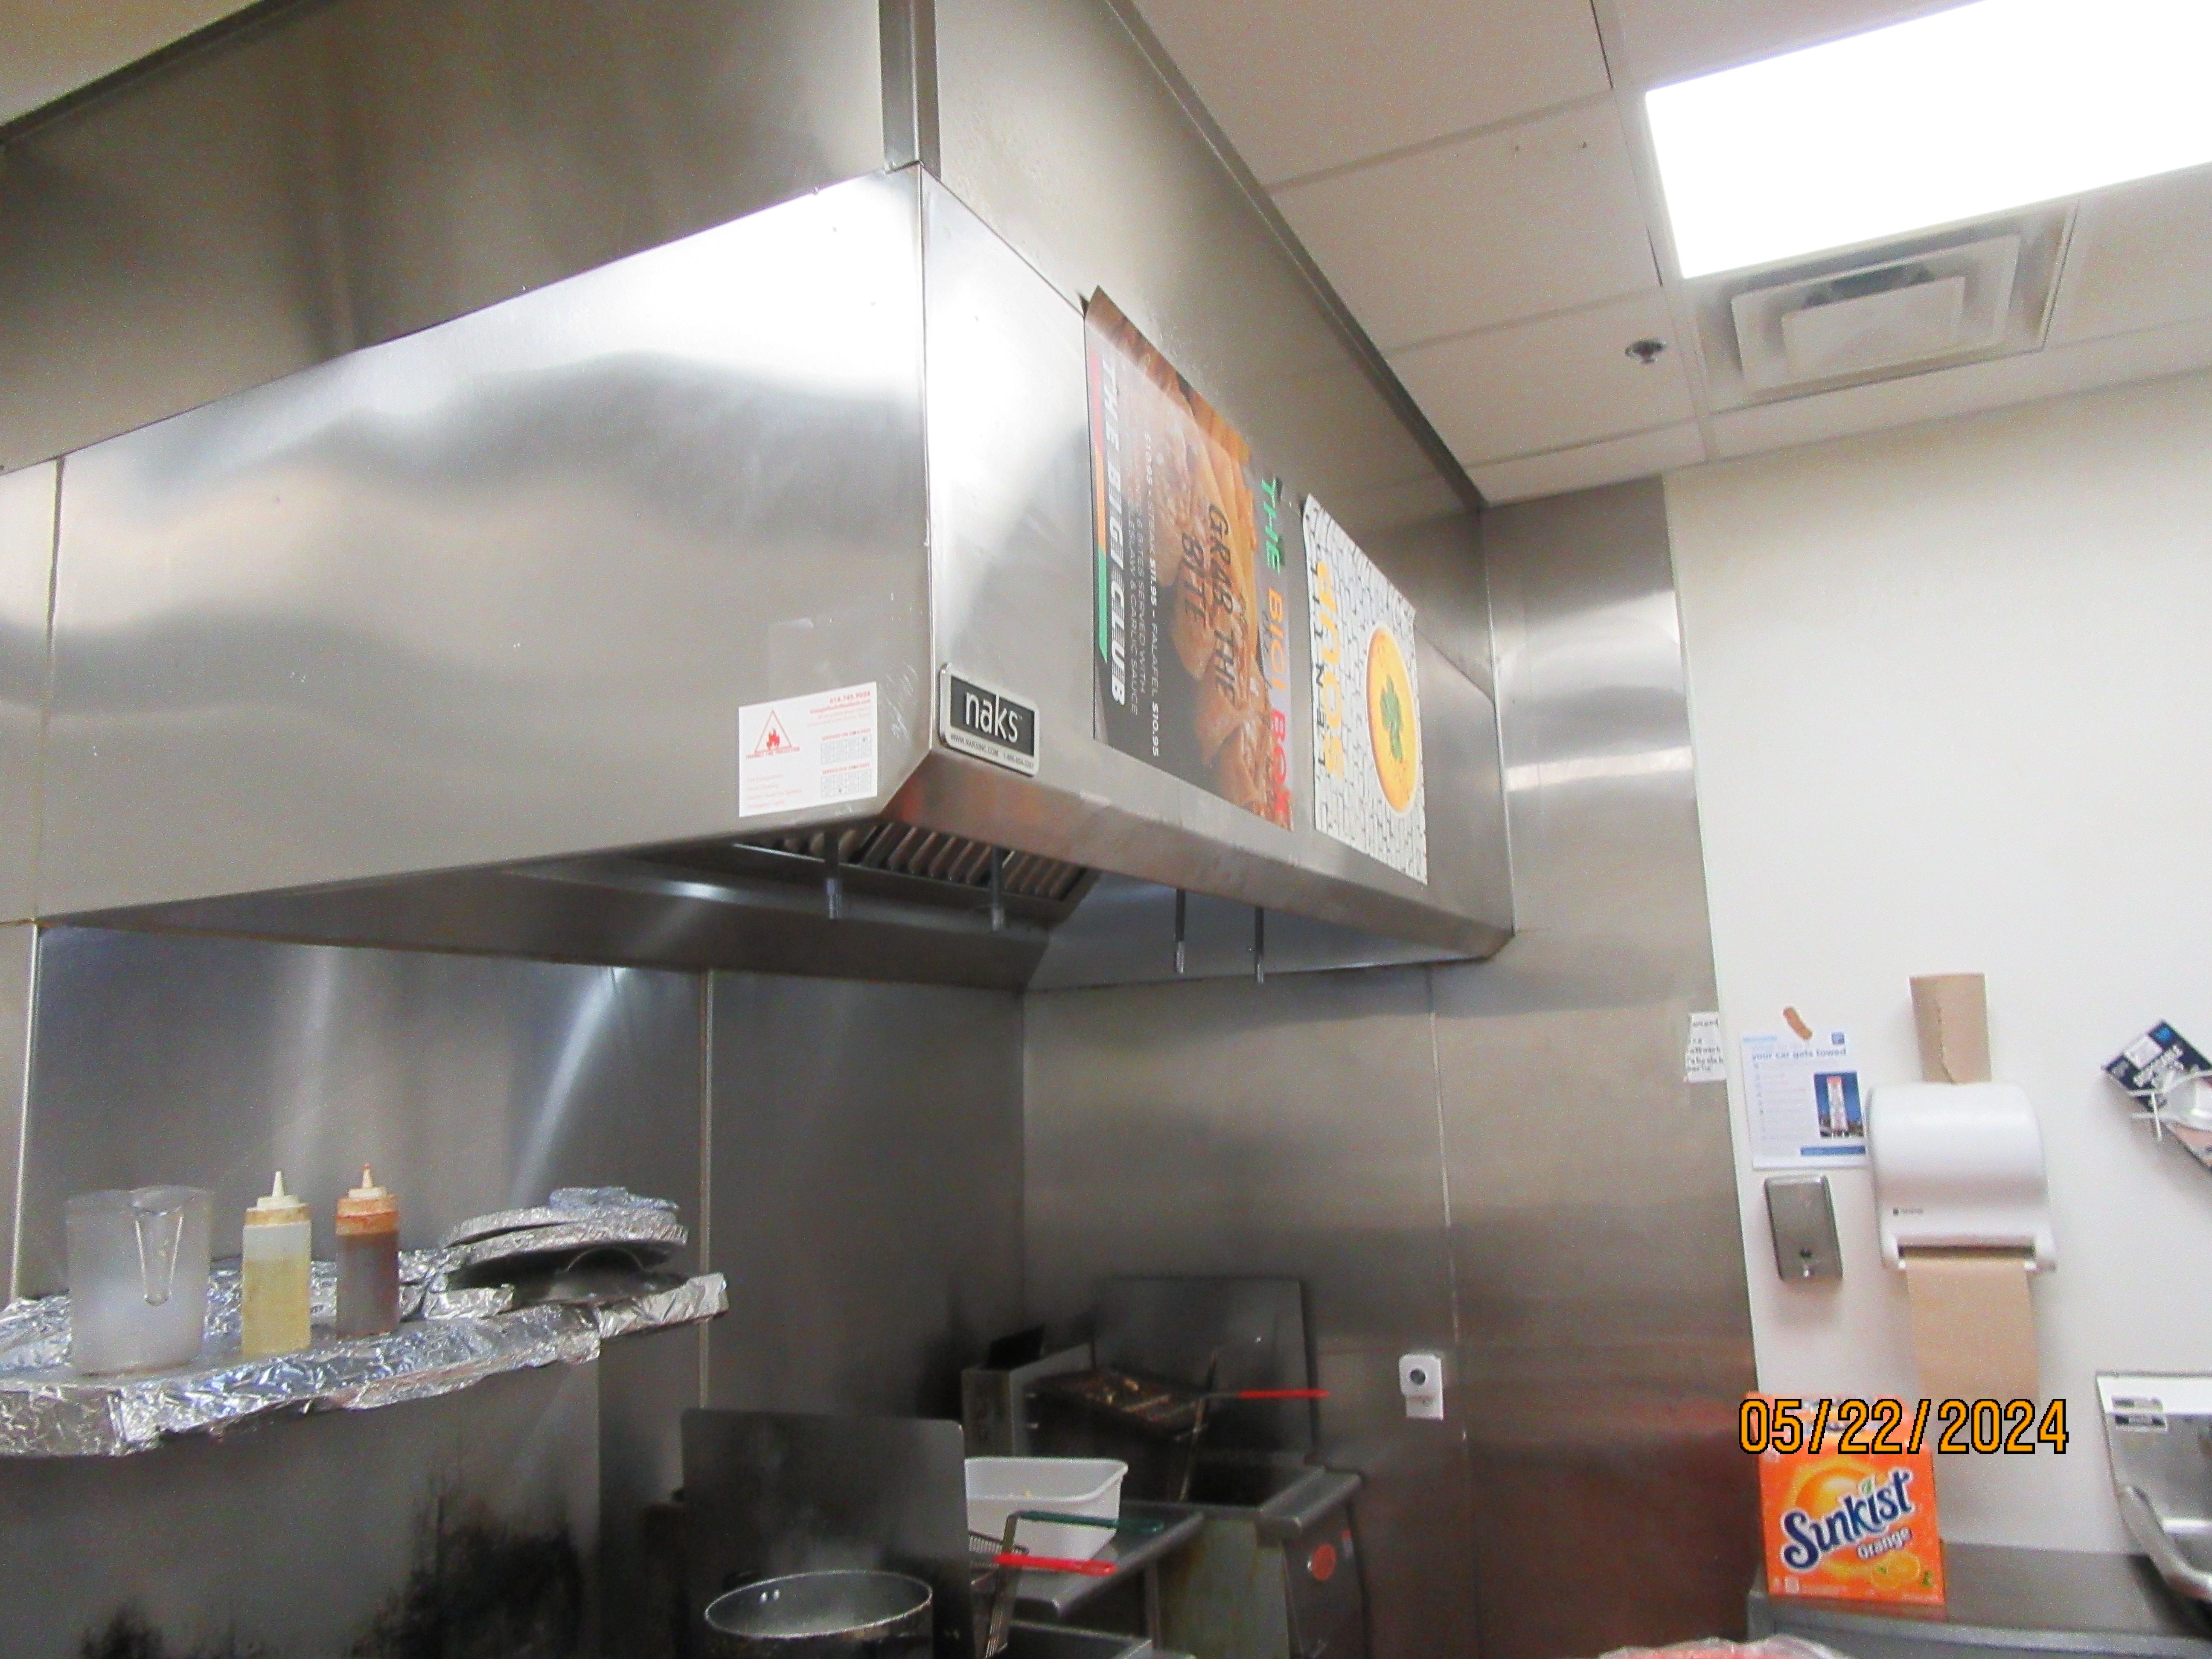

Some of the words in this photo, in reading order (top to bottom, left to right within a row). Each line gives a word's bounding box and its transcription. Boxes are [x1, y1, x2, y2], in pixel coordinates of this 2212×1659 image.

[1103, 358, 1119, 451] THE
[1107, 464, 1123, 570] BIGI
[1147, 500, 1156, 556] STEAK
[1149, 555, 1157, 607] $11.95
[1182, 533, 1205, 625] BITE
[1209, 503, 1233, 617] GRAB
[1111, 579, 1126, 706] CLUB
[1129, 590, 1138, 656] GARLIC
[1137, 579, 1146, 649] SERVED
[1262, 474, 1280, 574] THE
[1272, 709, 1287, 817] BOX
[1129, 656, 1138, 716] SAUCE
[1150, 620, 1158, 699] FALAFEL
[1215, 626, 1235, 706] THE
[1311, 565, 1327, 766] LENTIL
[1316, 561, 1343, 779] SOUP
[966, 693, 1018, 743] naks
[1151, 700, 1160, 759] $10.95
[1784, 1470, 1914, 1569] Sunkist
[1856, 1527, 1913, 1560] Orange
